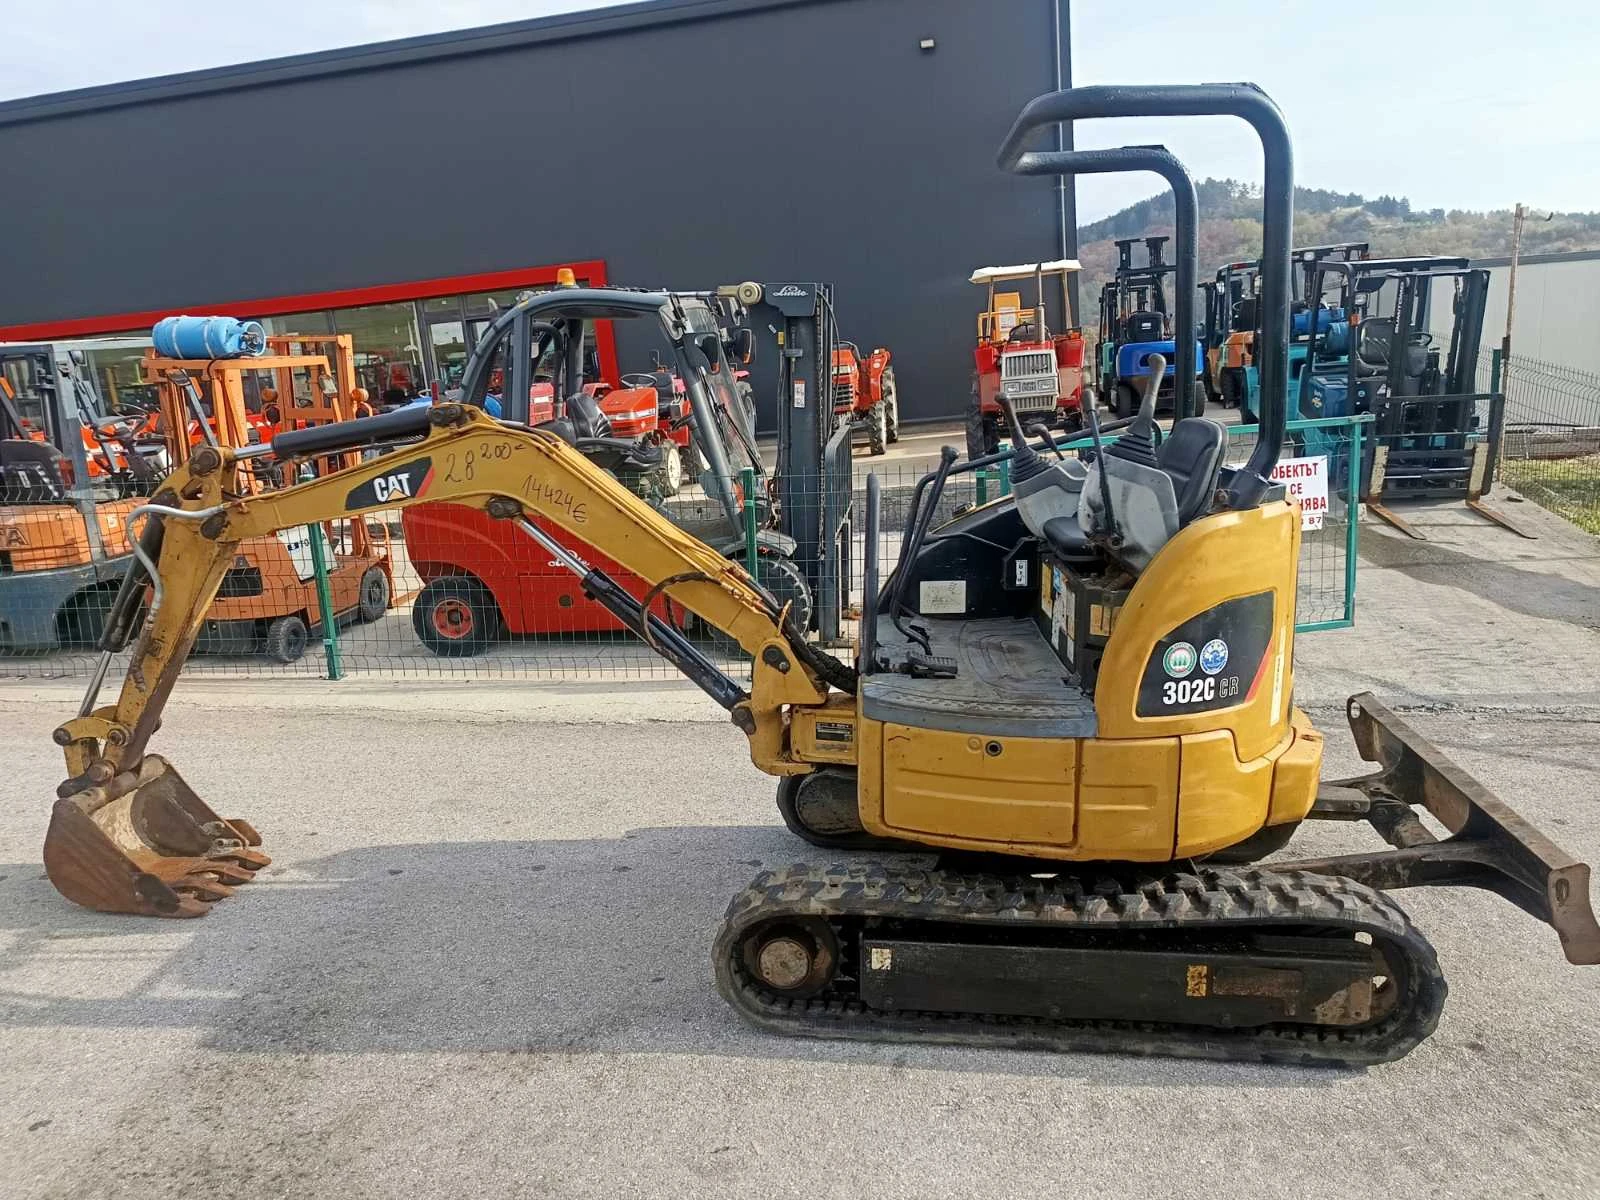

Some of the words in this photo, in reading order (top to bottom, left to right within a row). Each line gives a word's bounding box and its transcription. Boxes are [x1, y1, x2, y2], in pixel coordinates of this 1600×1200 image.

[772, 285, 808, 297] Linde
[1271, 462, 1319, 480] ОБЕКТЪТ
[373, 472, 411, 503] CAT
[1290, 483, 1303, 495] СЕ
[1297, 496, 1327, 511] НЯВА
[1308, 516, 1322, 525] 87
[1162, 676, 1215, 705] 302C
[1219, 676, 1240, 699] CR
